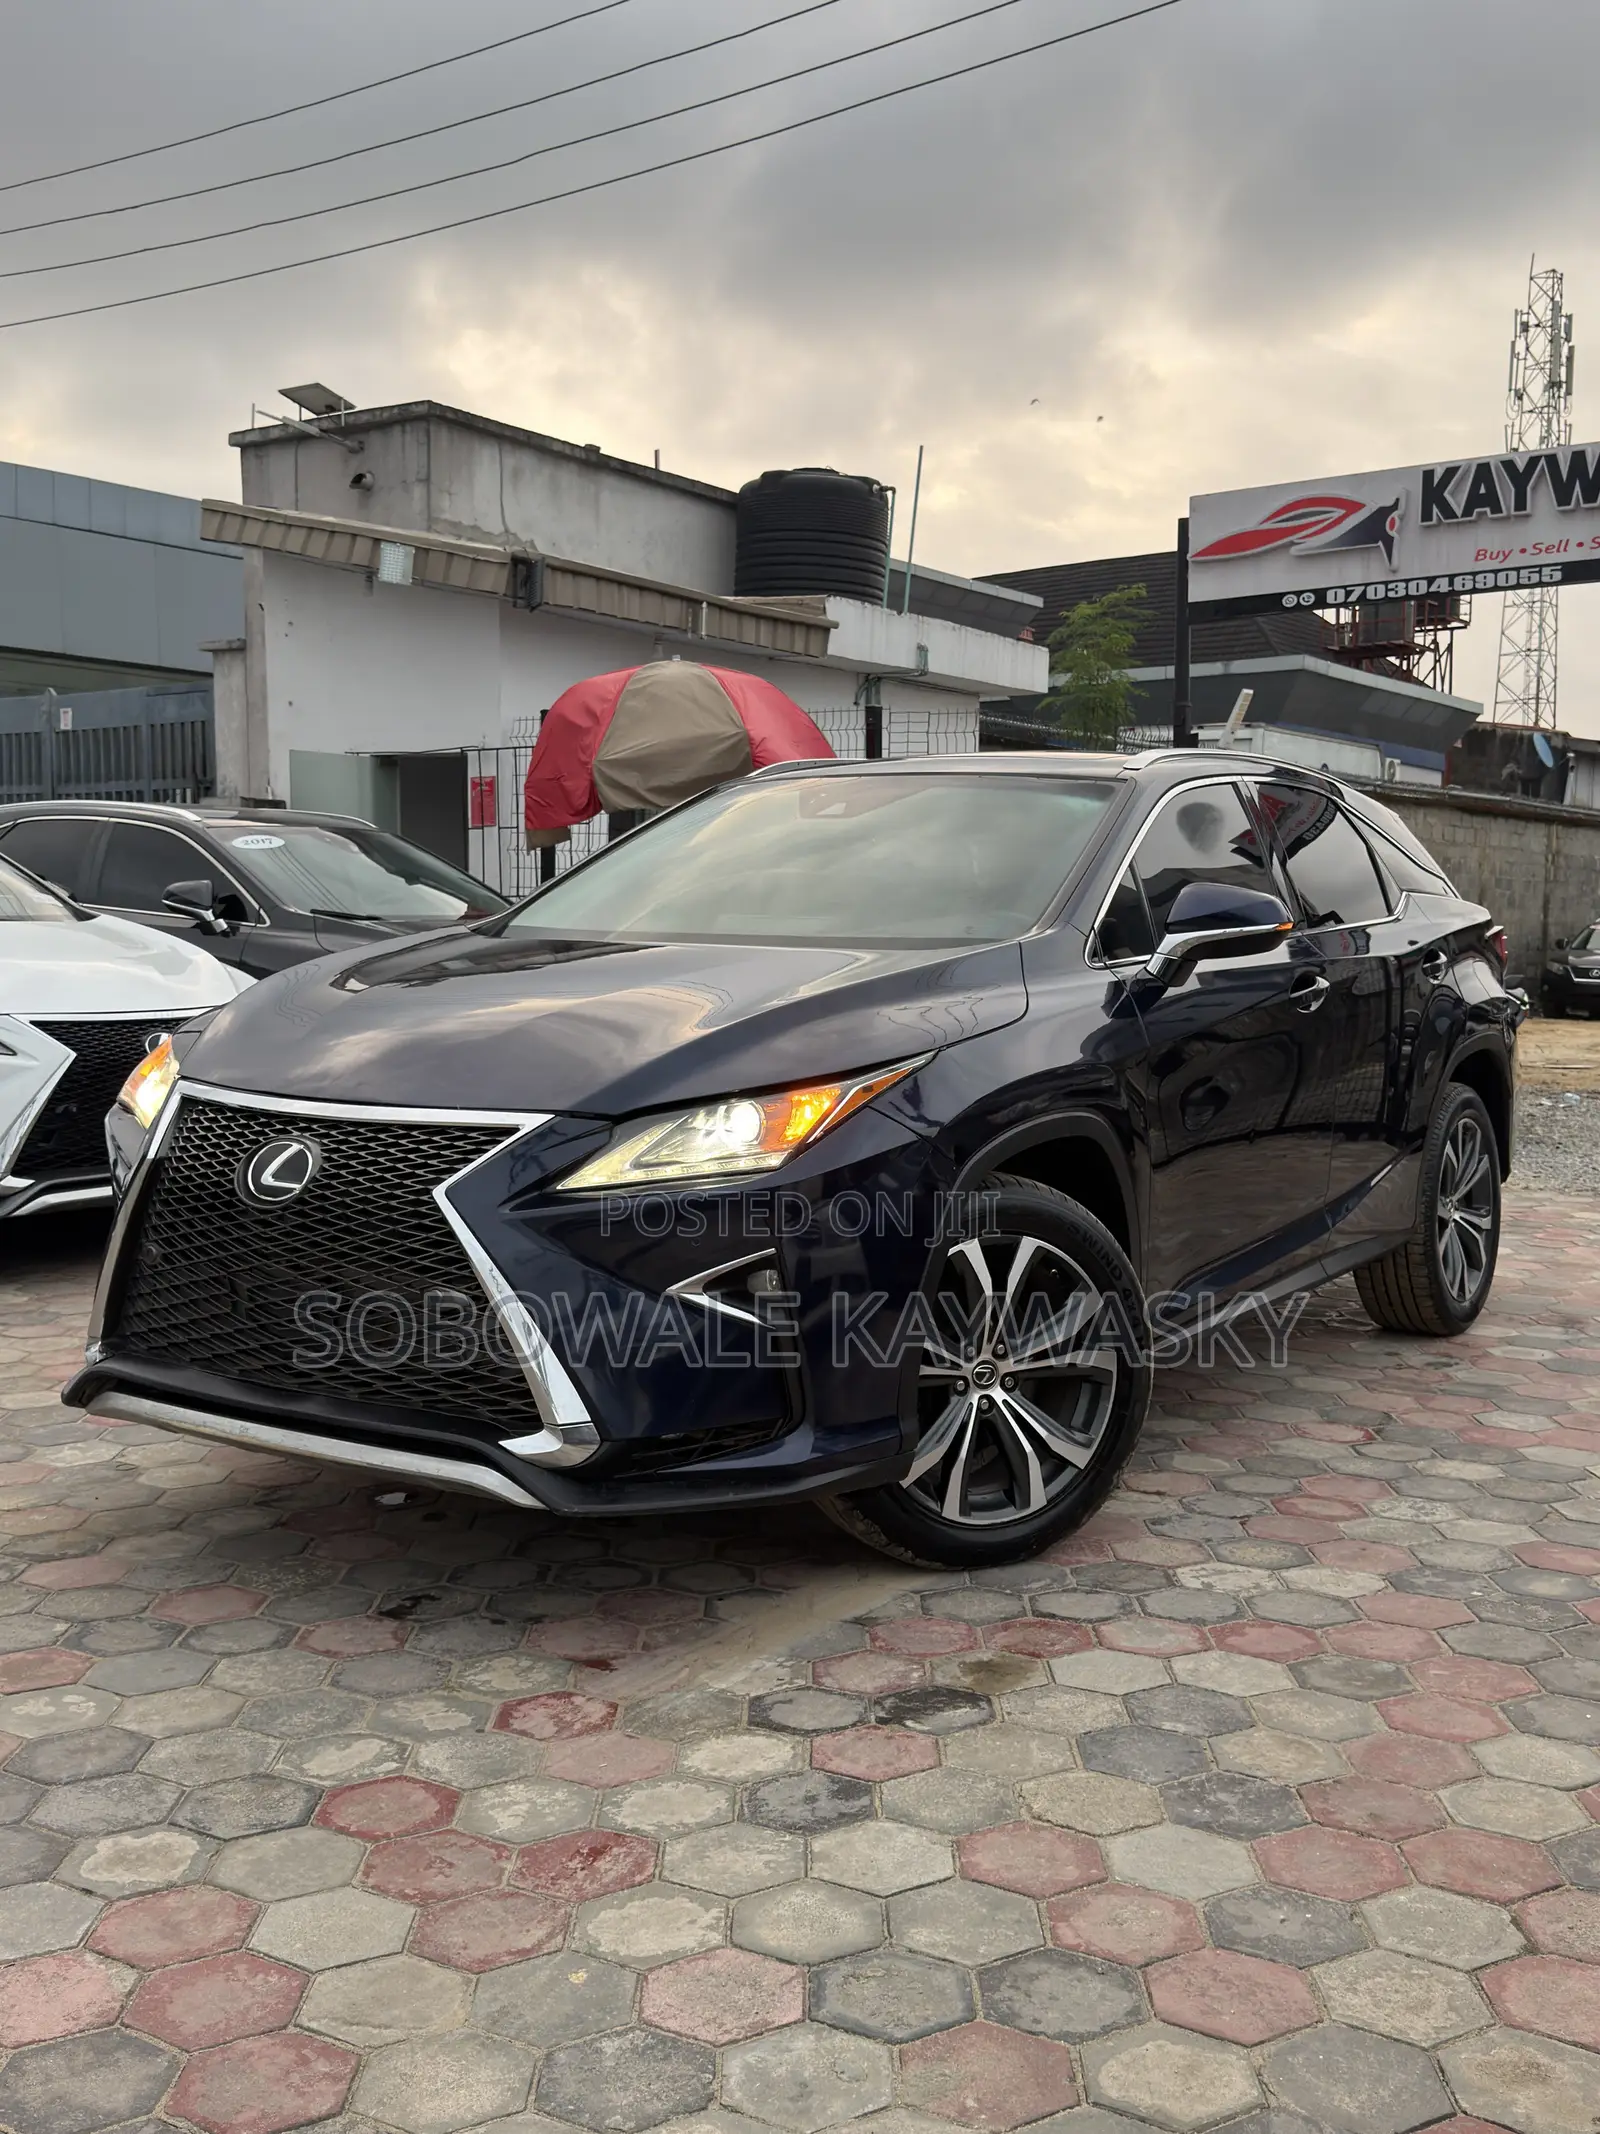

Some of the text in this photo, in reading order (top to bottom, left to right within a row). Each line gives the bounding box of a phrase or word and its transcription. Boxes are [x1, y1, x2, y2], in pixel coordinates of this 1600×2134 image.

[1474, 548, 1513, 563] Buy
[1530, 538, 1570, 556] Sell
[1326, 565, 1563, 605] 07030469055
[243, 837, 273, 846] 2017
